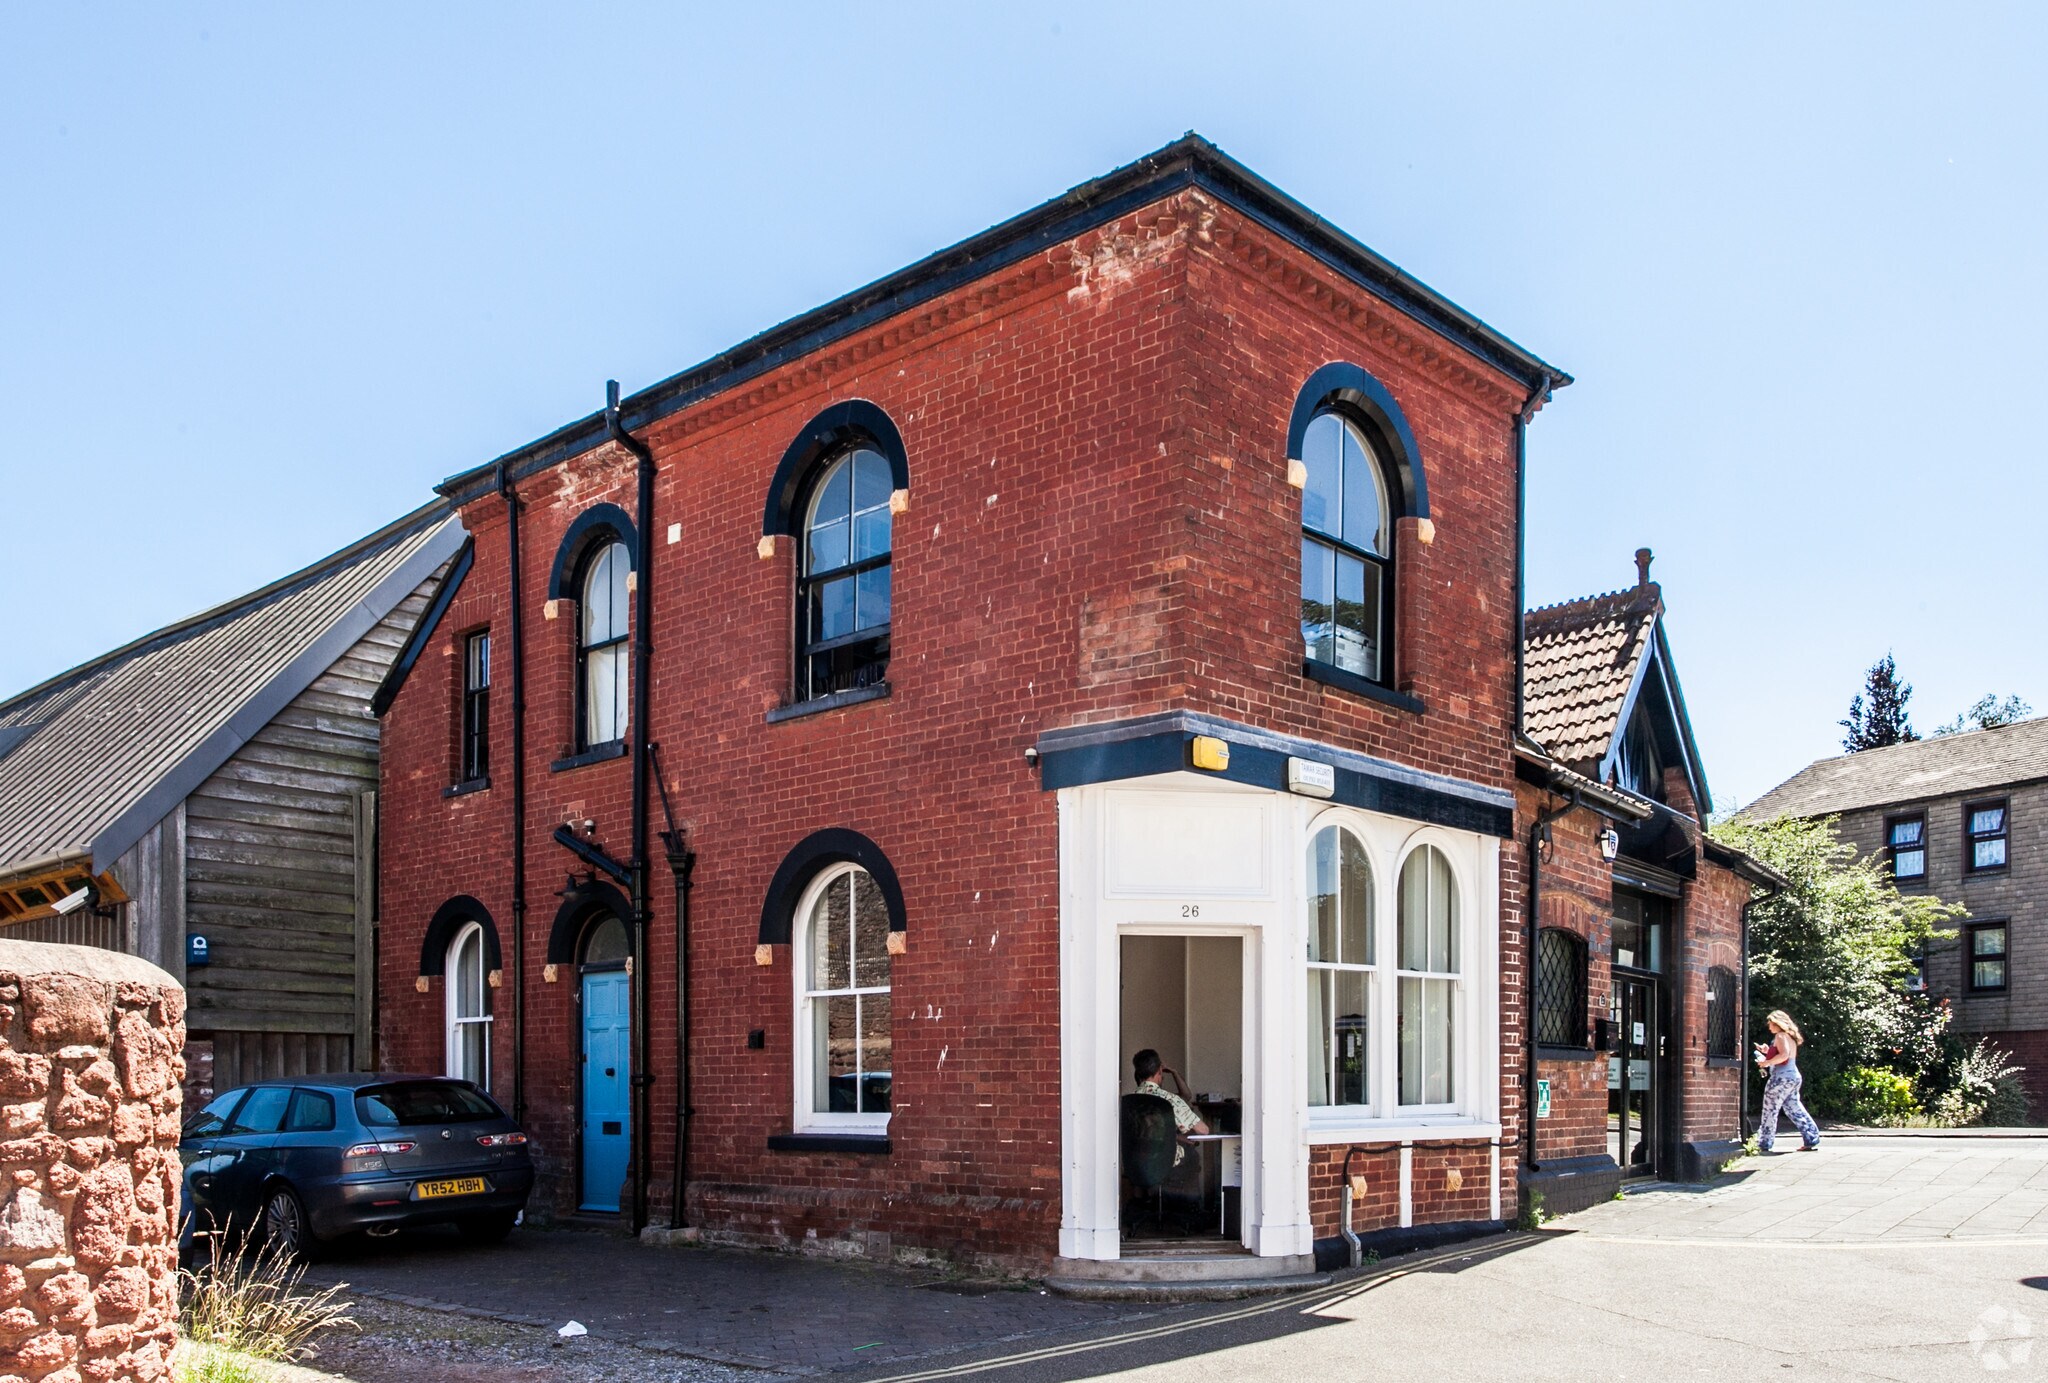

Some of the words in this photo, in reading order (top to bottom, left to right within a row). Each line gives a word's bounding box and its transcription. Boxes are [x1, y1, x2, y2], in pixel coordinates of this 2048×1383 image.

[1182, 904, 1199, 918] 26
[422, 1181, 456, 1196] YR52
[456, 1179, 481, 1192] HBH
